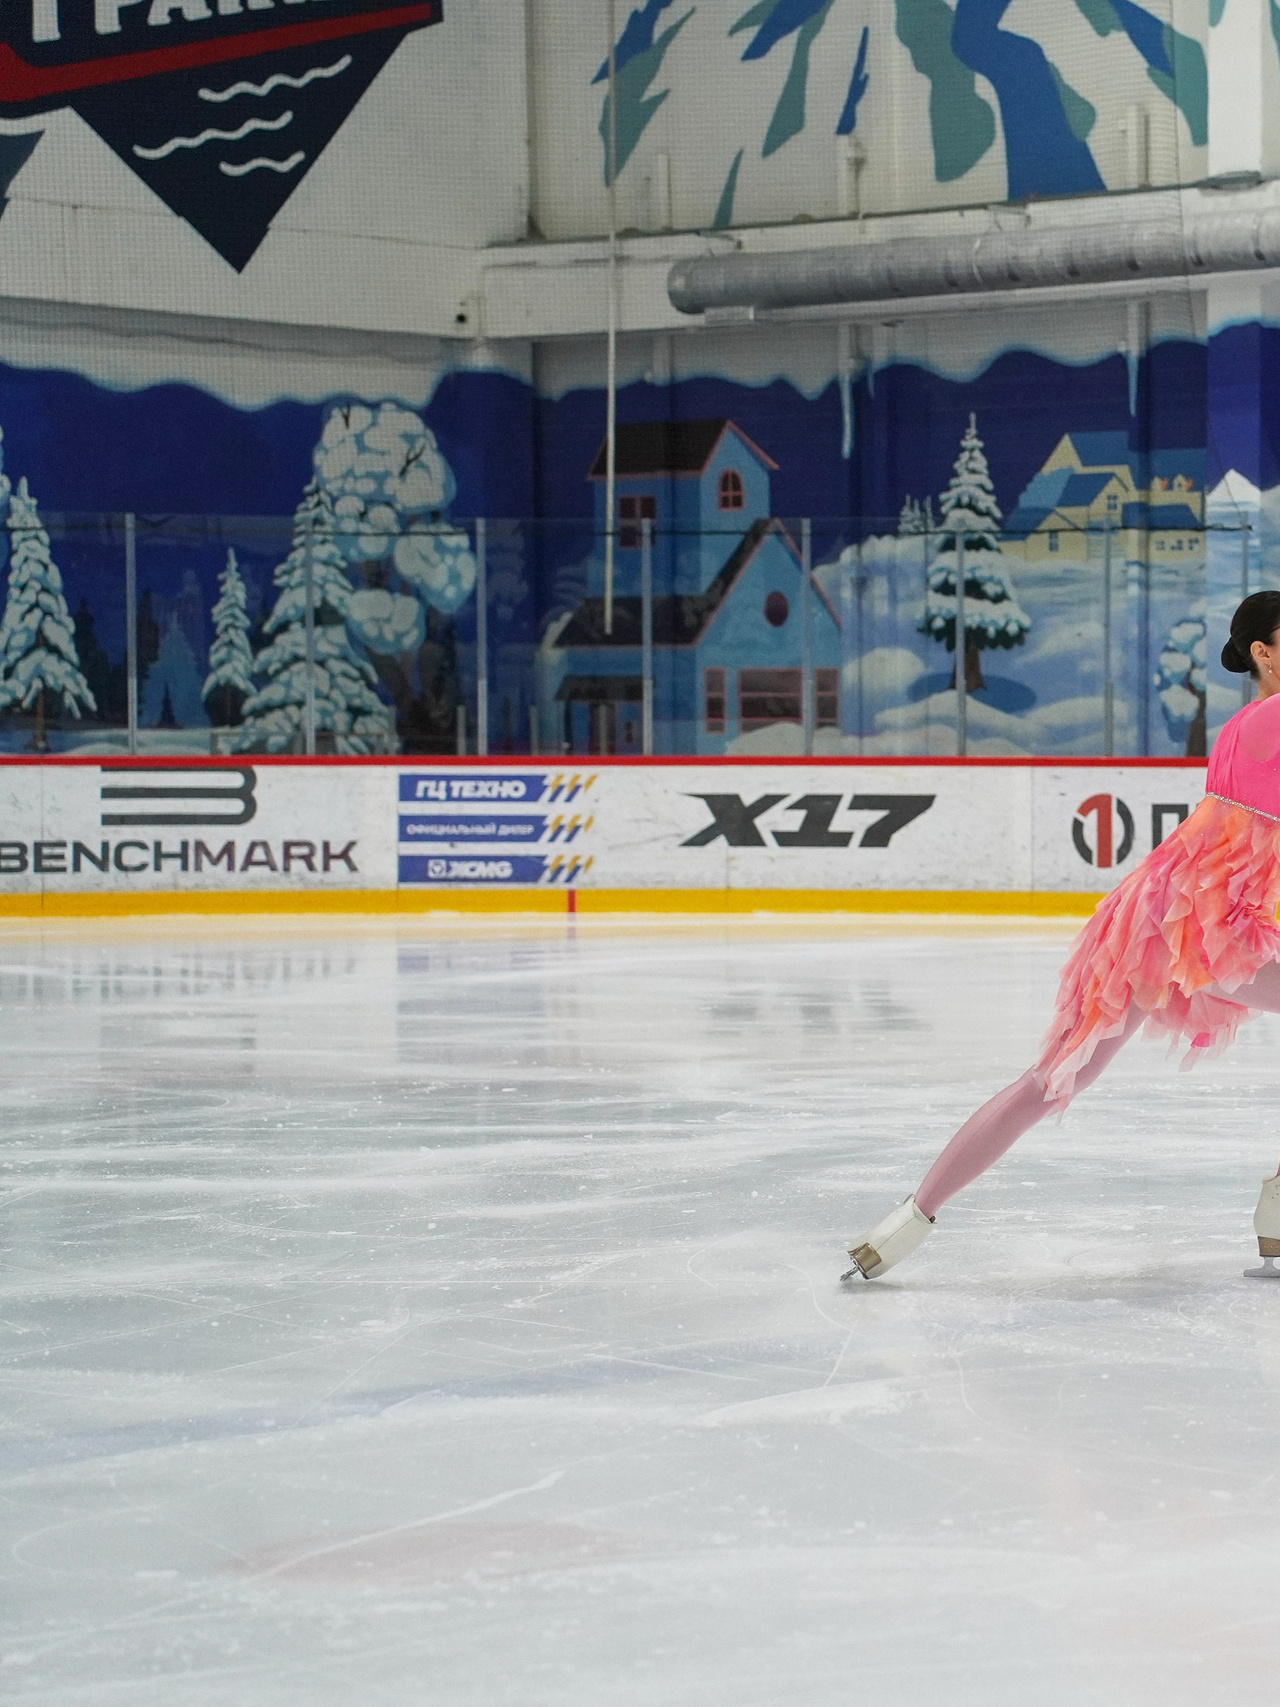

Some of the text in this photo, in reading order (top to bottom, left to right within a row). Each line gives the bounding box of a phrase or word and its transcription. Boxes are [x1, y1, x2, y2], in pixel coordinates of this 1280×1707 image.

[416, 780, 527, 800] ГЦ ТЕХНО
[679, 793, 937, 848] X17
[0, 840, 358, 873] BENCHMARK
[447, 861, 513, 879] XCMG
